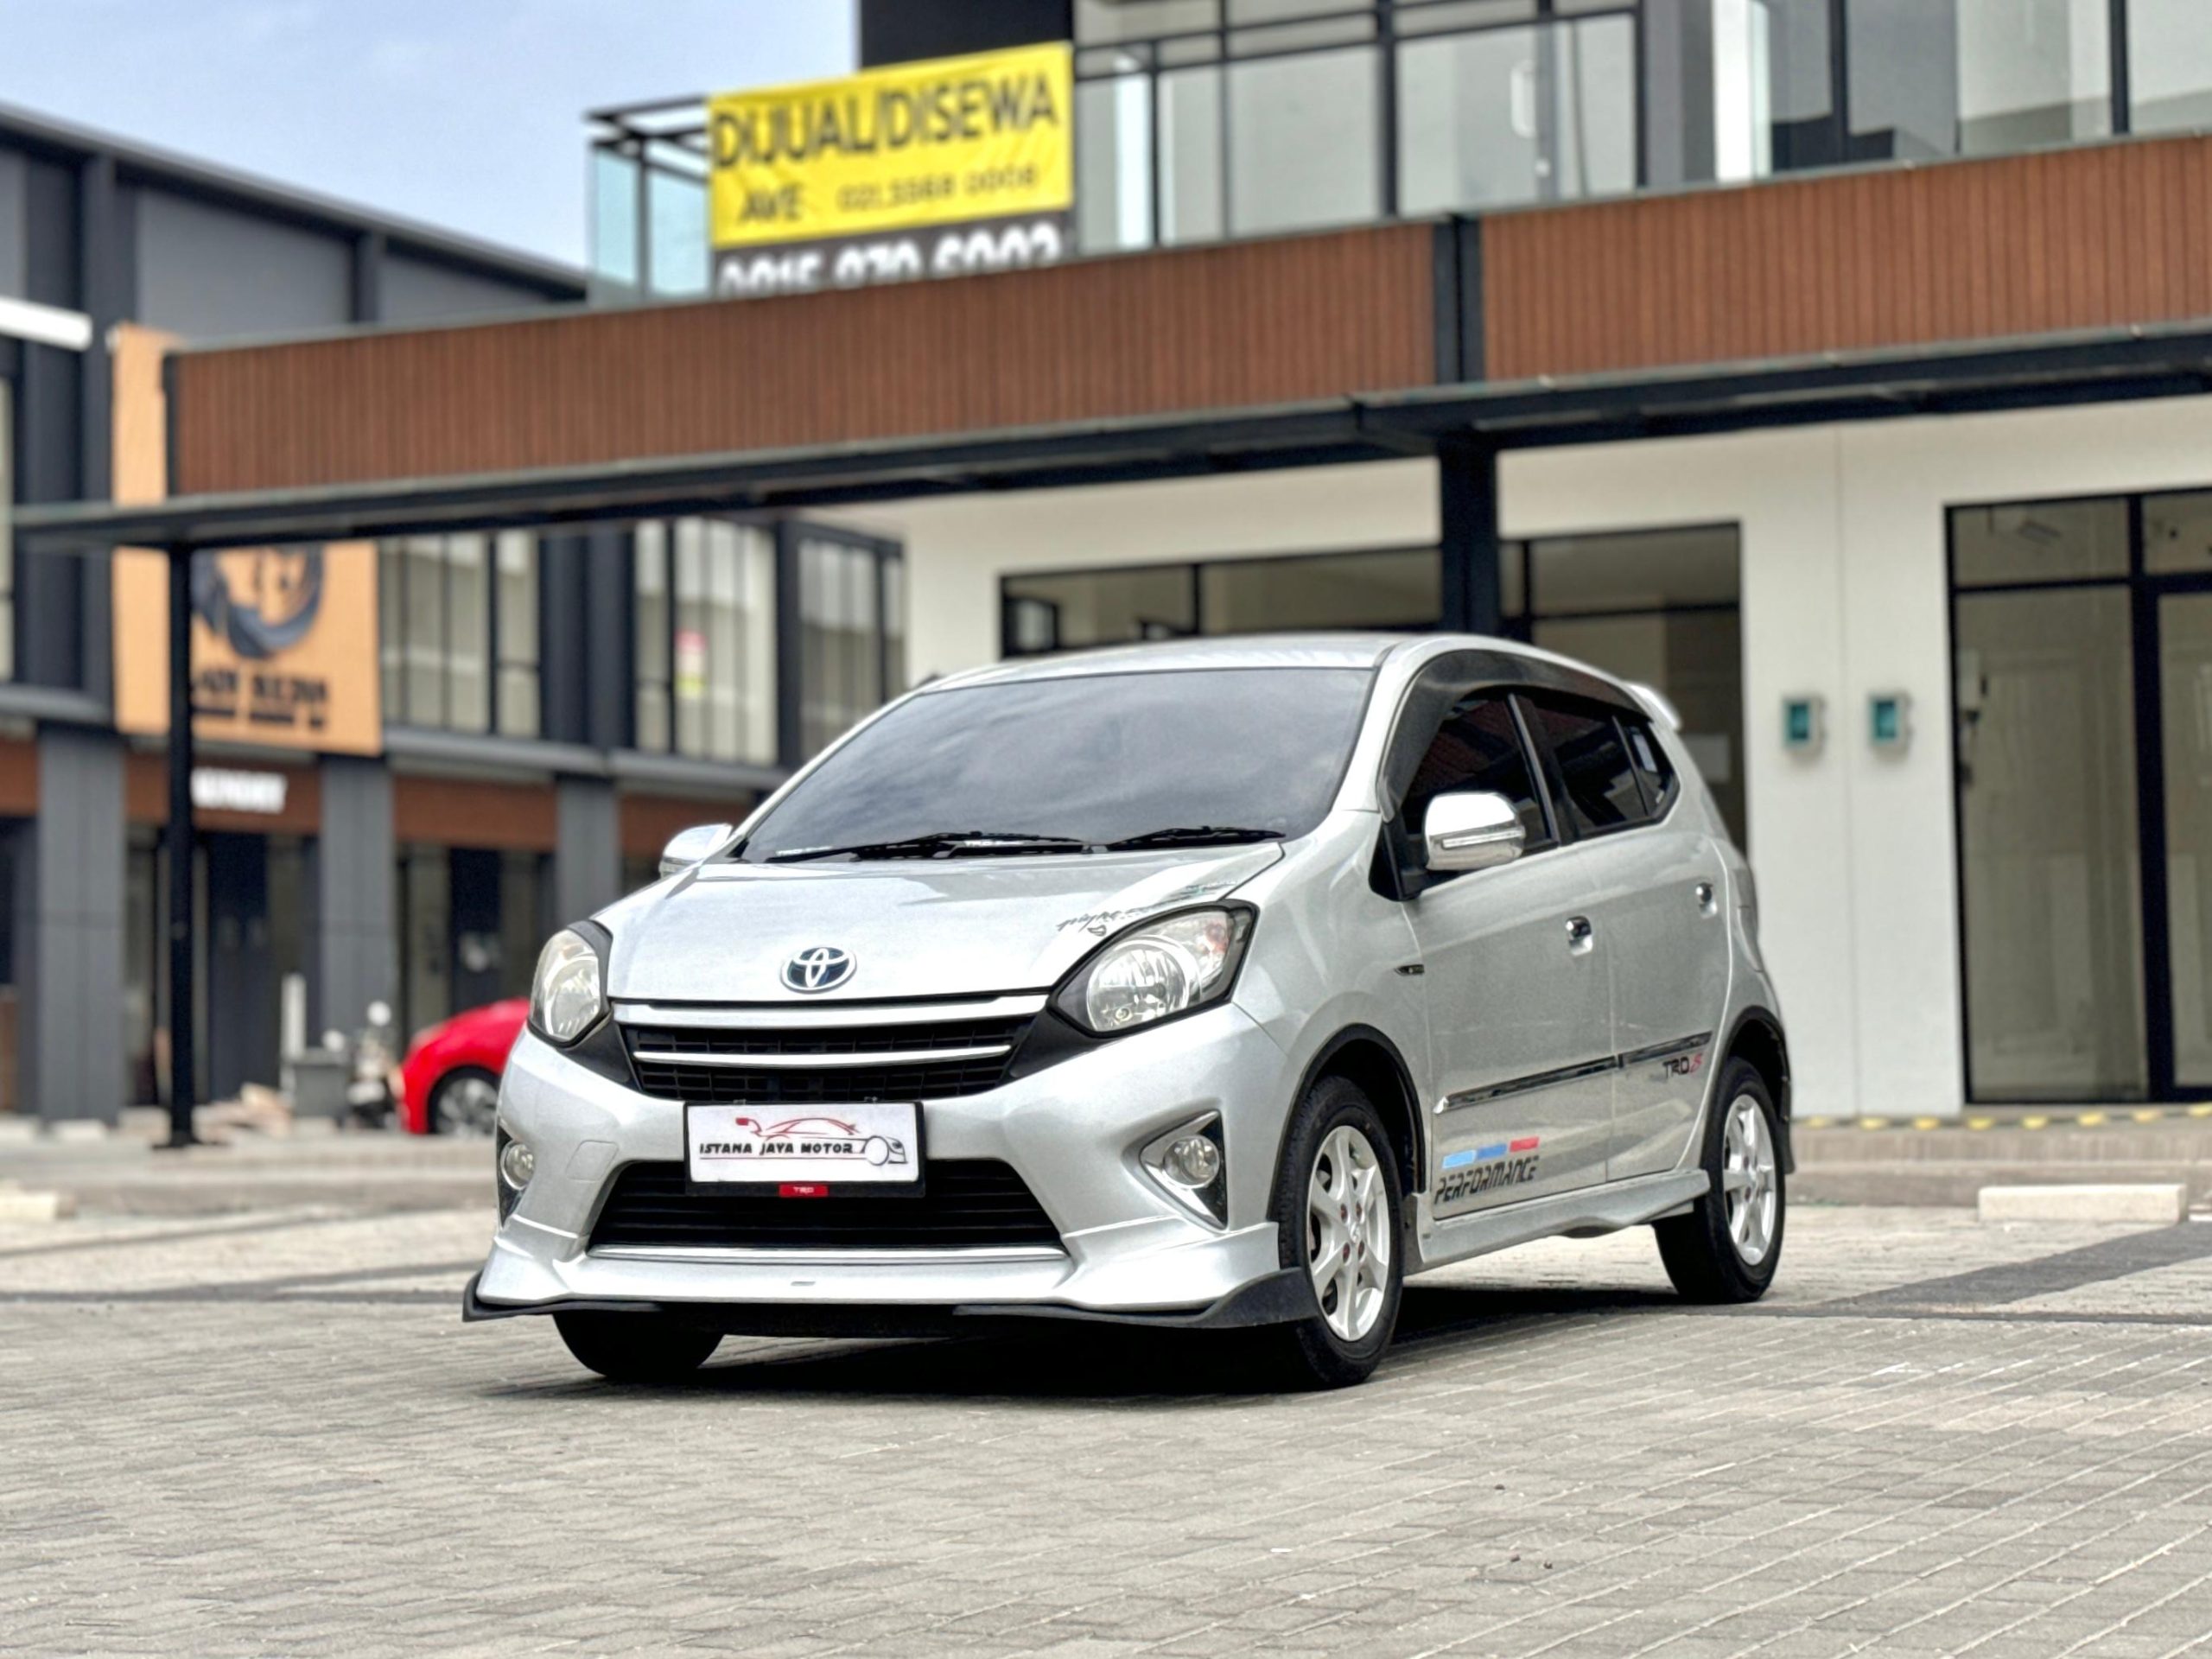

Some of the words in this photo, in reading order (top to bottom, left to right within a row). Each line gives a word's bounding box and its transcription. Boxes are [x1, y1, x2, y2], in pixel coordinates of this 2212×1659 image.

[699, 1142, 753, 1154] ISTANA
[759, 1142, 794, 1156] JAYA
[800, 1142, 854, 1154] MOTOR
[1434, 1155, 1539, 1205] PERFORMANCE
